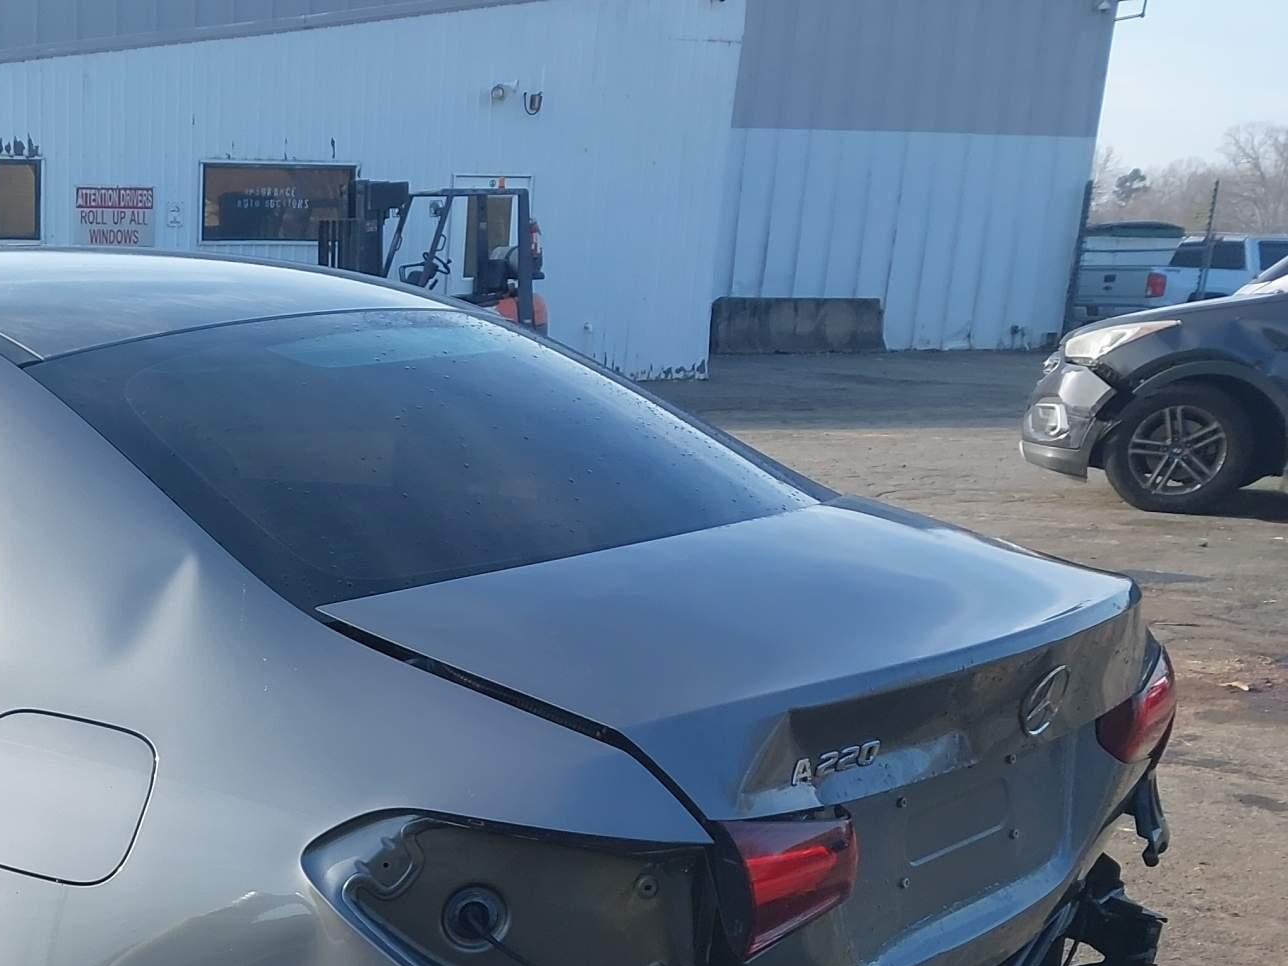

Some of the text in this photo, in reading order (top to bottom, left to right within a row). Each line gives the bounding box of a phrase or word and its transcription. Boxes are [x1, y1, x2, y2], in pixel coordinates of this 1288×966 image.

[76, 188, 153, 208] ATTENTION DRIVERS
[80, 210, 149, 225] ROLL UP ALL
[88, 229, 140, 244] WINDOWS
